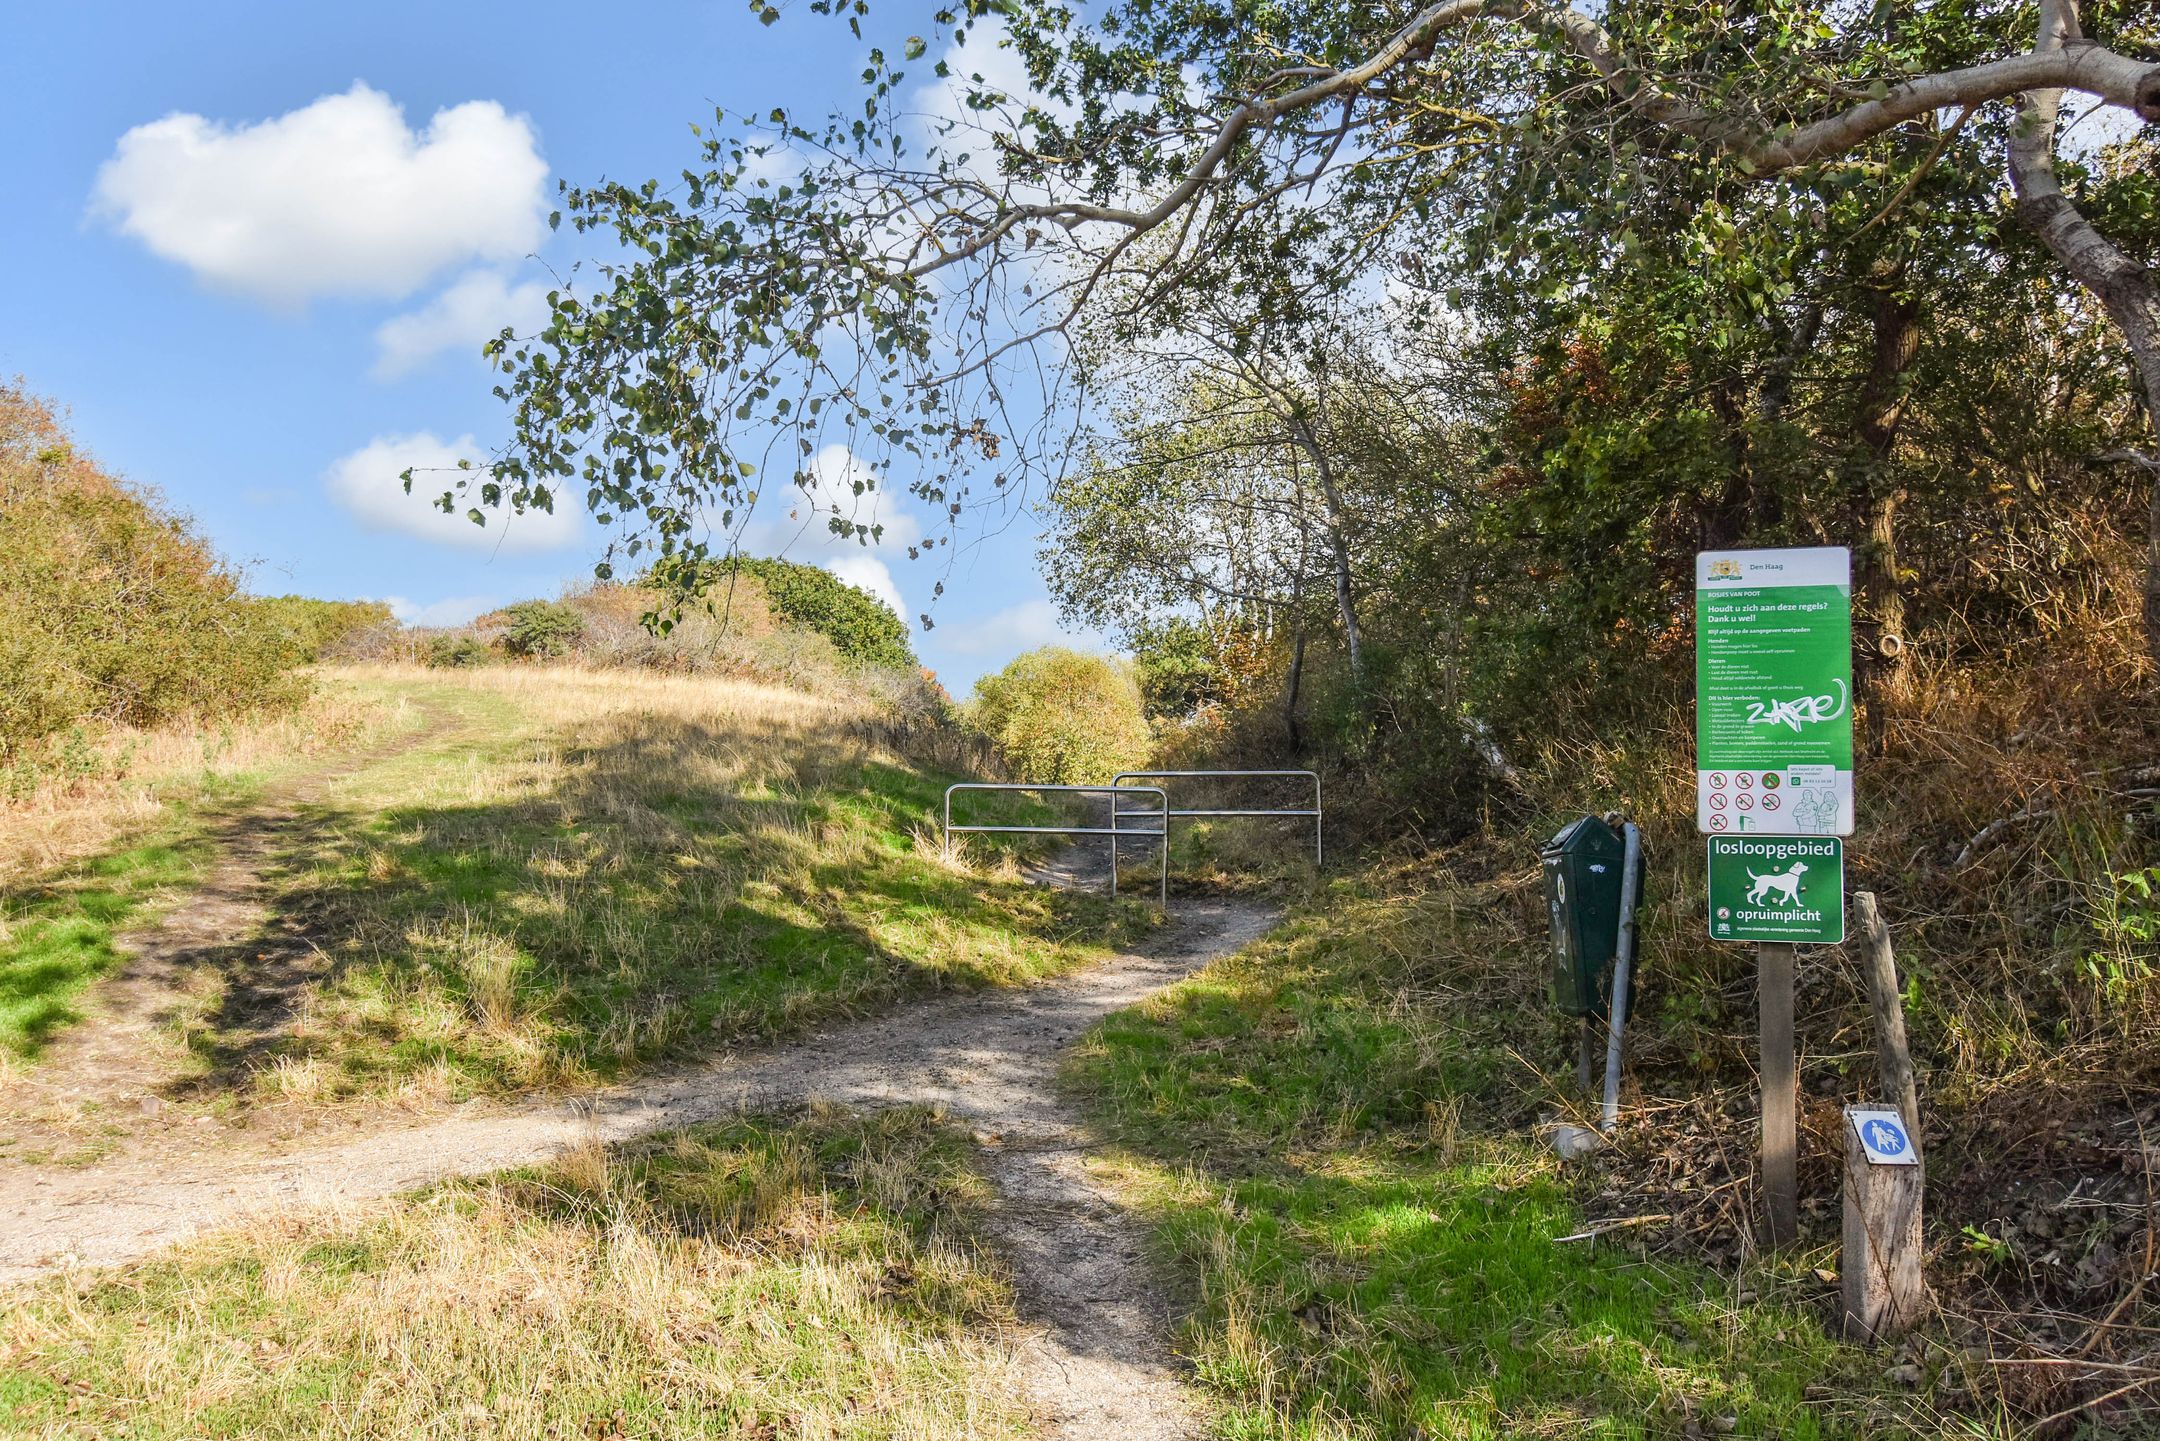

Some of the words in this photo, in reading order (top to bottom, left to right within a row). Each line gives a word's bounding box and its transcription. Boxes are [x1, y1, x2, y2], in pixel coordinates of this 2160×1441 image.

[1798, 602, 1828, 612] regels?
[1716, 840, 1834, 859] losloopgebied
[1736, 909, 1821, 923] opruimplicht
